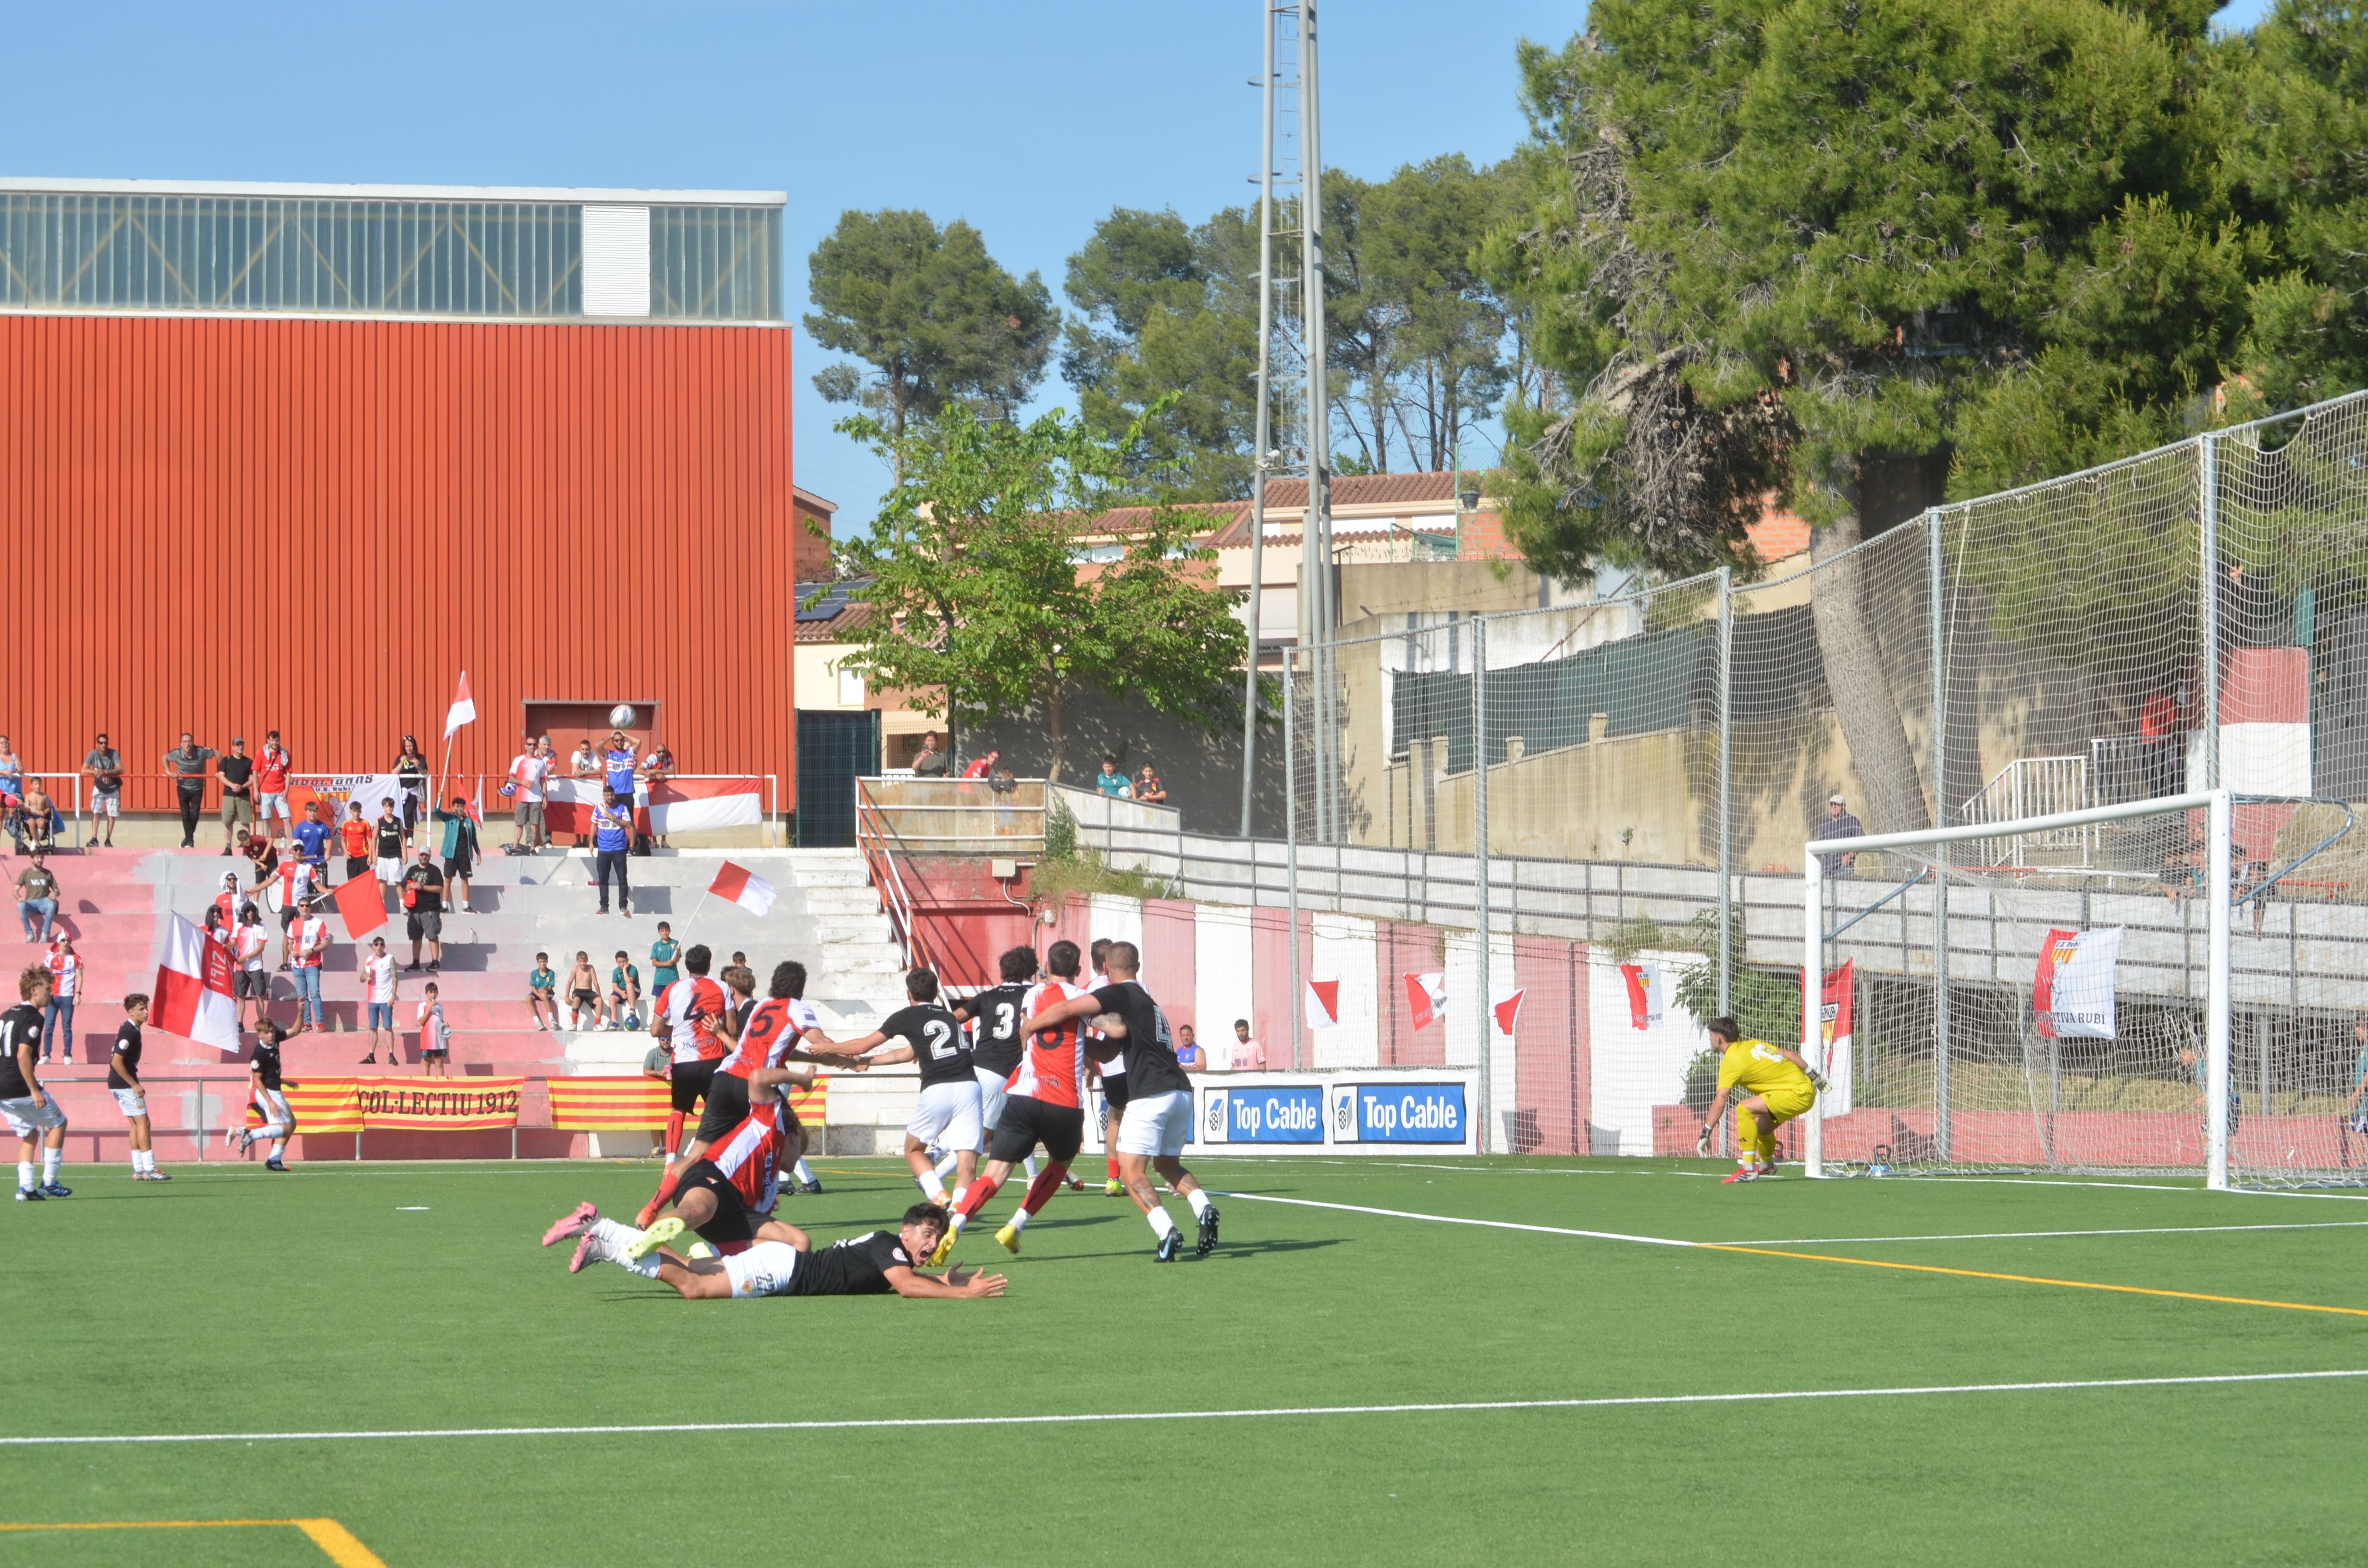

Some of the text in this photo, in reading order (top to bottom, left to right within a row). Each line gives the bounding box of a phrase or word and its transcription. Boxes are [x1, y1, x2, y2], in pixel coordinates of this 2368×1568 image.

[210, 950, 226, 987] 1912
[749, 1005, 783, 1038] 5
[992, 1003, 1015, 1040] 3
[476, 1090, 518, 1115] 1912
[1233, 1098, 1316, 1137] Top Cable
[1363, 1095, 1457, 1137] Top Cable
